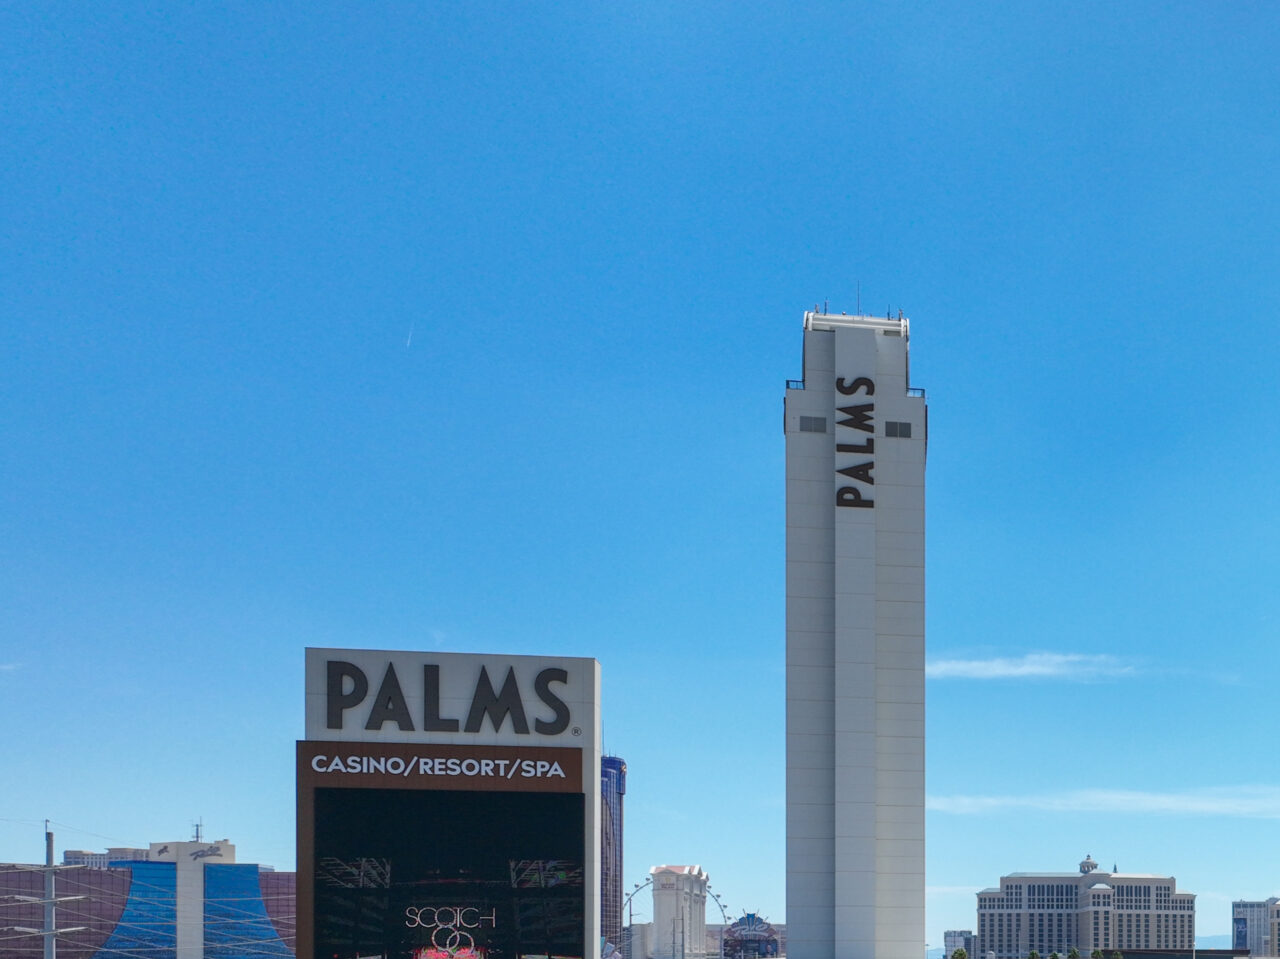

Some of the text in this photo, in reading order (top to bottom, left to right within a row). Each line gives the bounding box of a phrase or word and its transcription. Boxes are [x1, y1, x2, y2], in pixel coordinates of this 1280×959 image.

[836, 377, 875, 508] PALMS
[311, 755, 566, 779] CASINO/RESORT/SPA
[405, 906, 496, 929] SCOTCH
